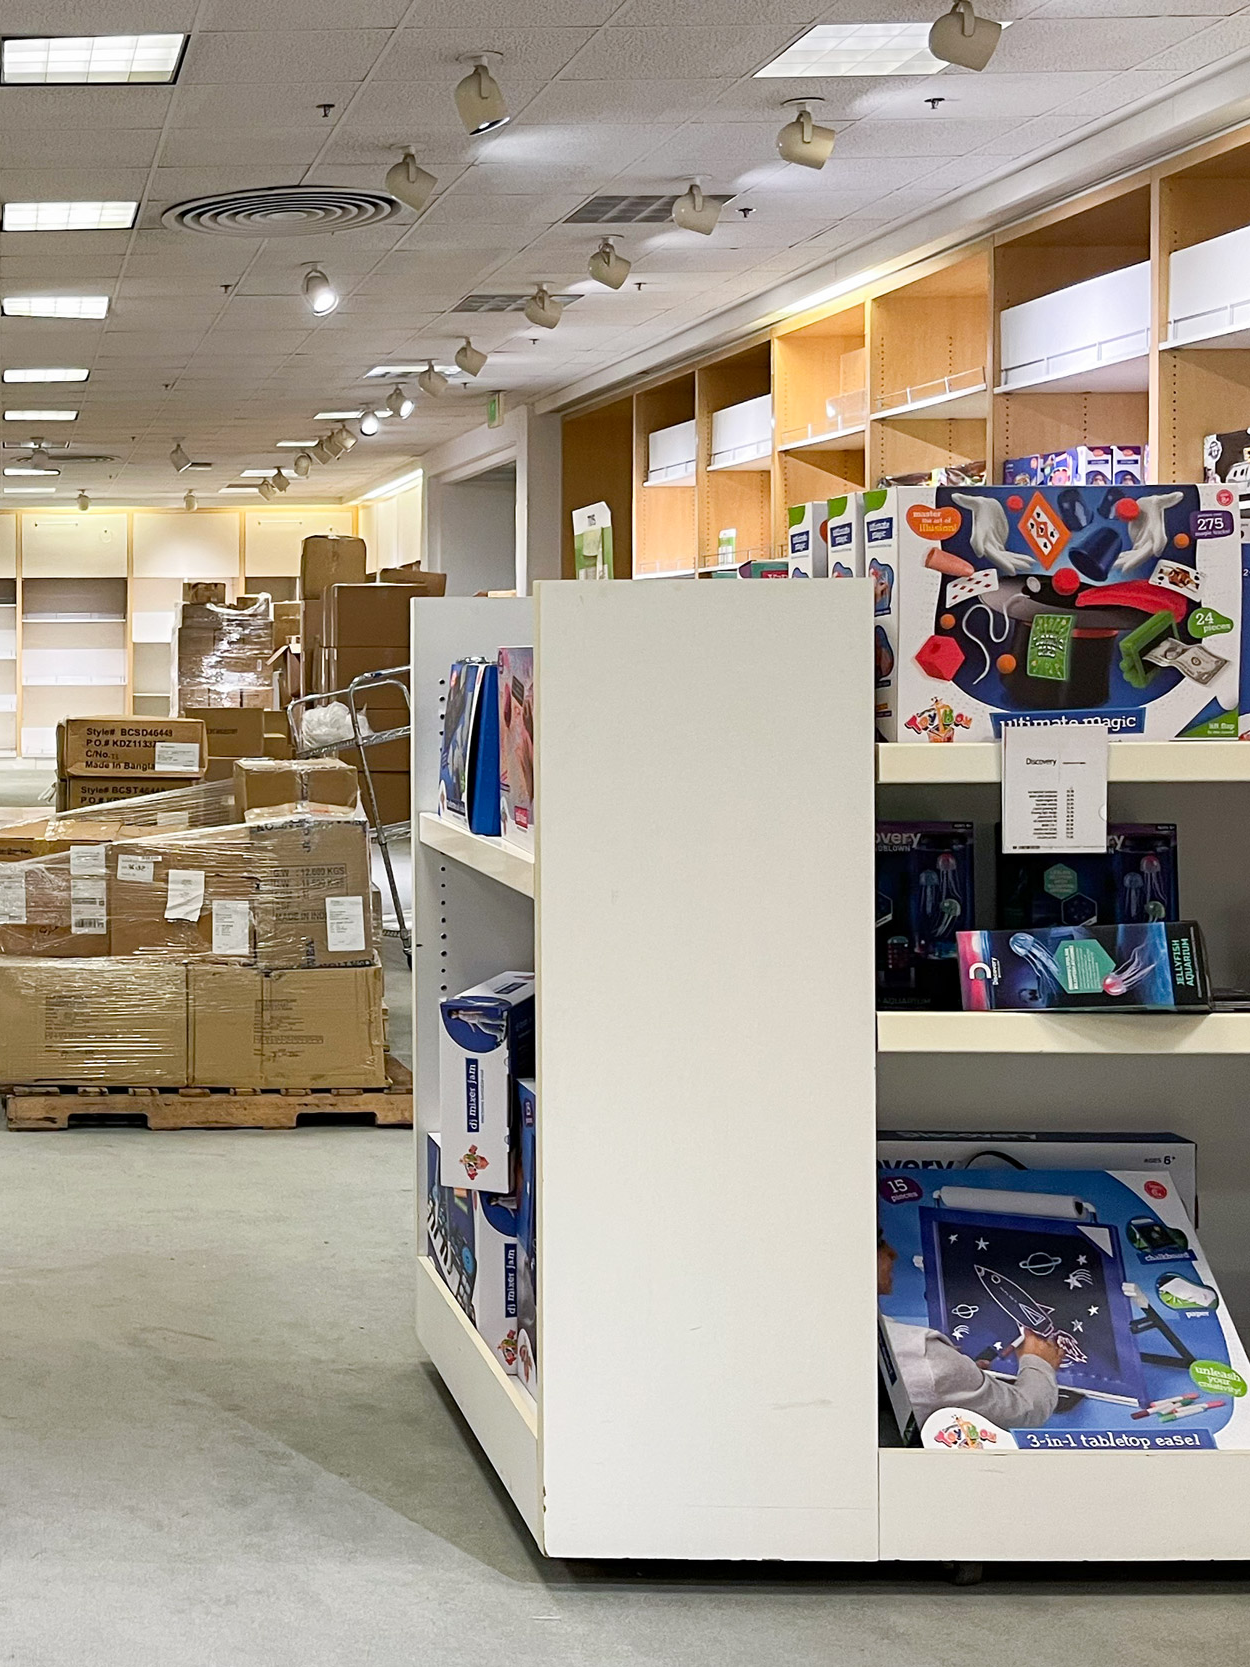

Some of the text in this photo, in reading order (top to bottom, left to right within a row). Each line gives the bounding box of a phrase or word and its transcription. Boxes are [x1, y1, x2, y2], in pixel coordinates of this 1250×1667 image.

[913, 510, 941, 518] master
[1197, 517, 1225, 531] 275
[1195, 612, 1215, 626] 24
[1203, 623, 1231, 633] pieces
[904, 712, 937, 734] Toy
[999, 715, 1137, 732] ultimate magic
[86, 728, 115, 737] Style#
[85, 760, 110, 769] Made
[1025, 757, 1057, 767] Discovery
[80, 786, 109, 796] Style#
[1171, 939, 1185, 986] JELLYFISH
[1180, 938, 1195, 987] AQUARIUM
[467, 1064, 477, 1085] jam
[468, 1087, 477, 1117] mixer
[887, 1179, 908, 1194] 15
[506, 1249, 516, 1270] jam
[506, 1272, 516, 1302] mixer
[1194, 1366, 1242, 1382] unleash
[1206, 1376, 1231, 1386] your
[1026, 1431, 1201, 1450] 3-in-1 tabletop easel
